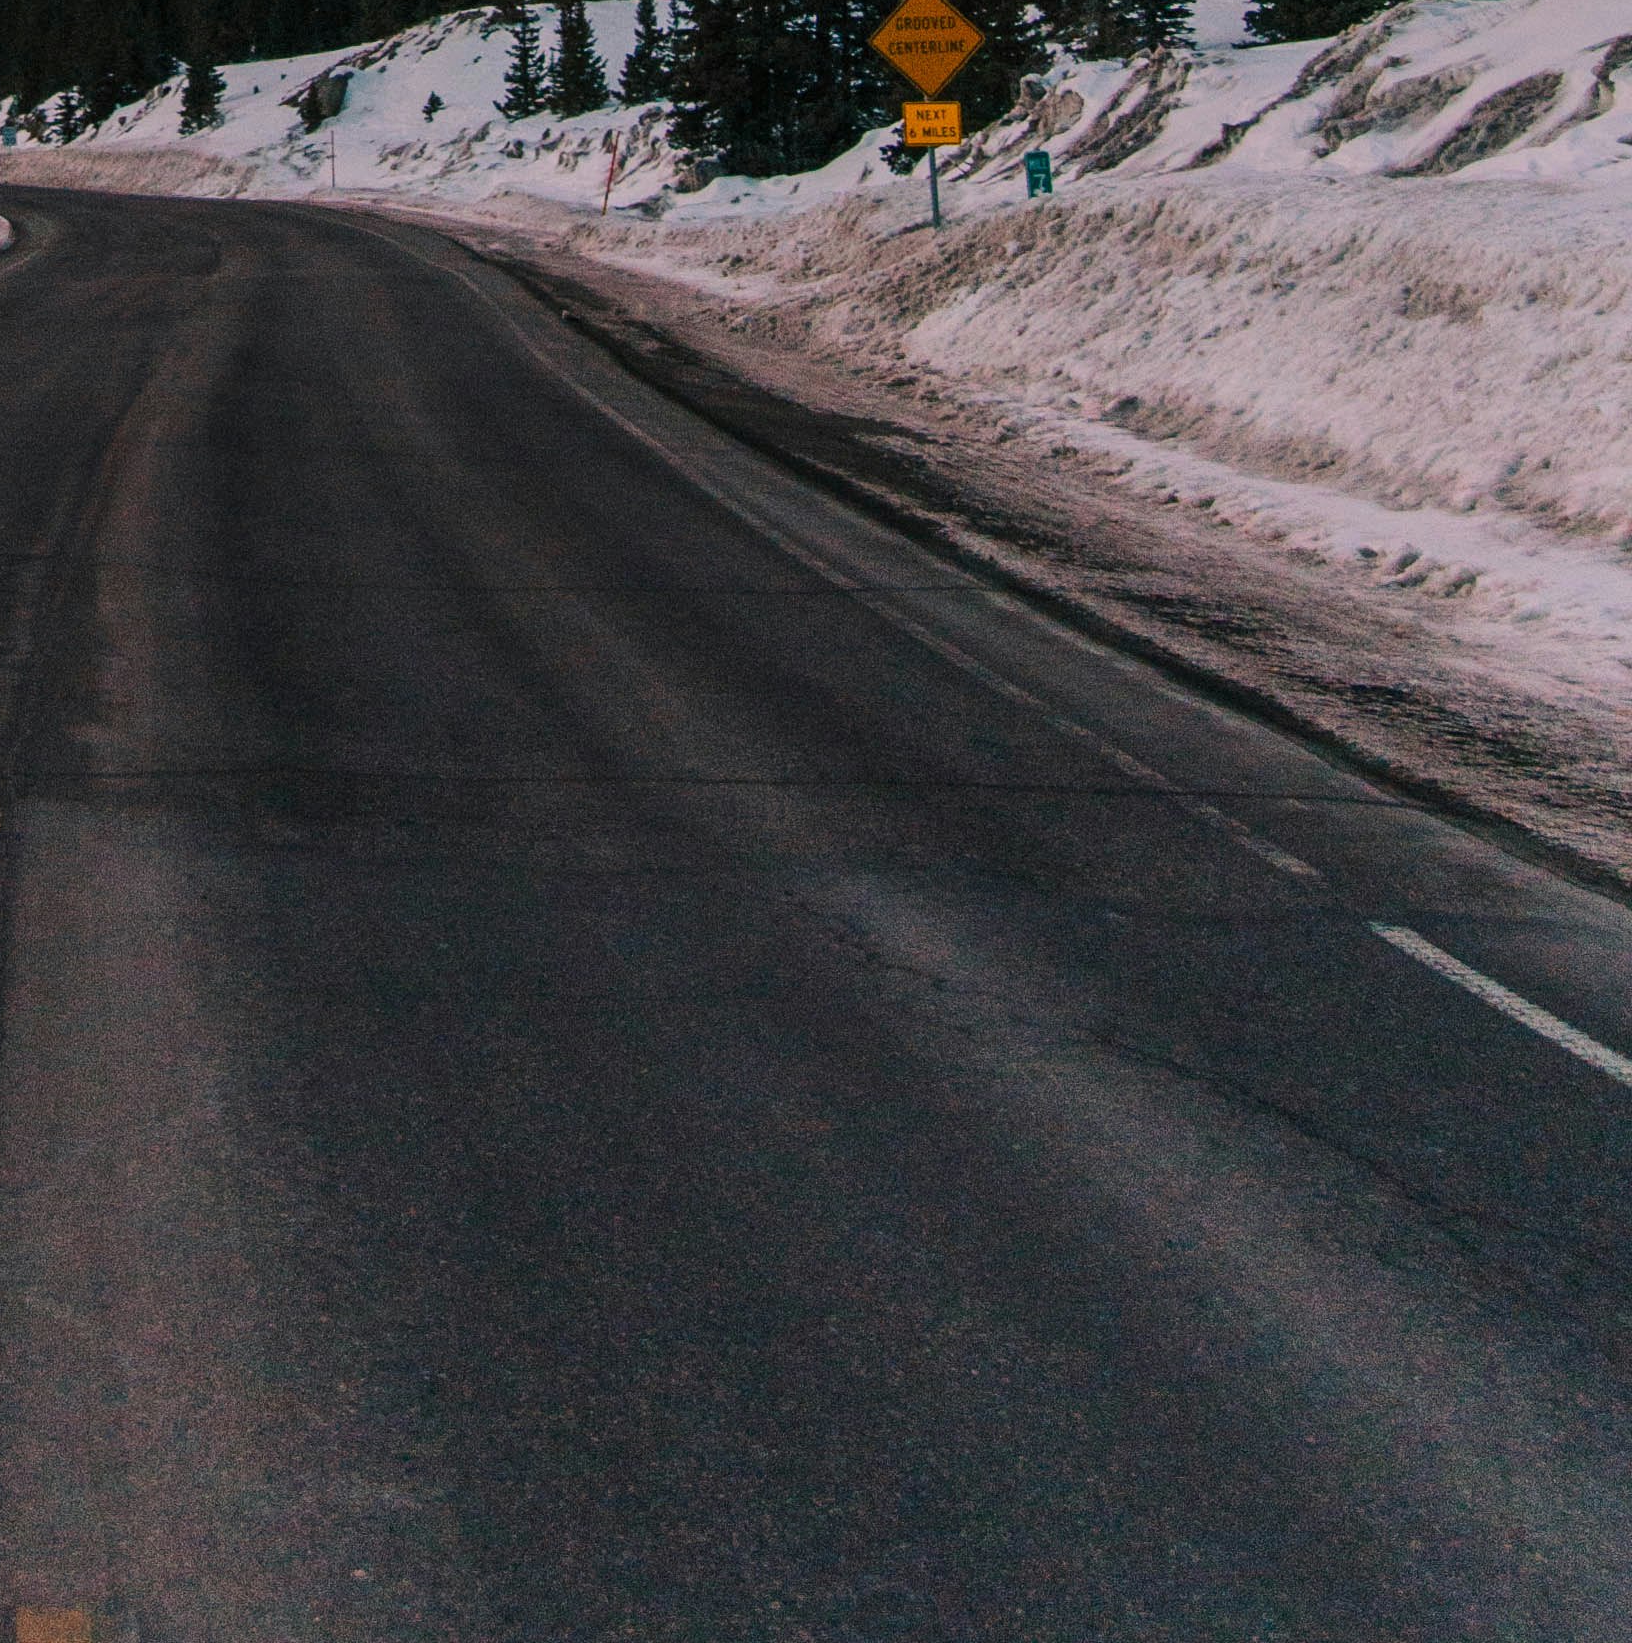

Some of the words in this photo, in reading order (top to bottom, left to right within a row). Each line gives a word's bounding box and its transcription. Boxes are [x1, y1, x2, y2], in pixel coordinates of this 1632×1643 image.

[896, 16, 956, 30] GROOVED
[889, 40, 967, 55] CENTERLINE
[916, 109, 946, 121] NEXT
[923, 125, 957, 138] MILES
